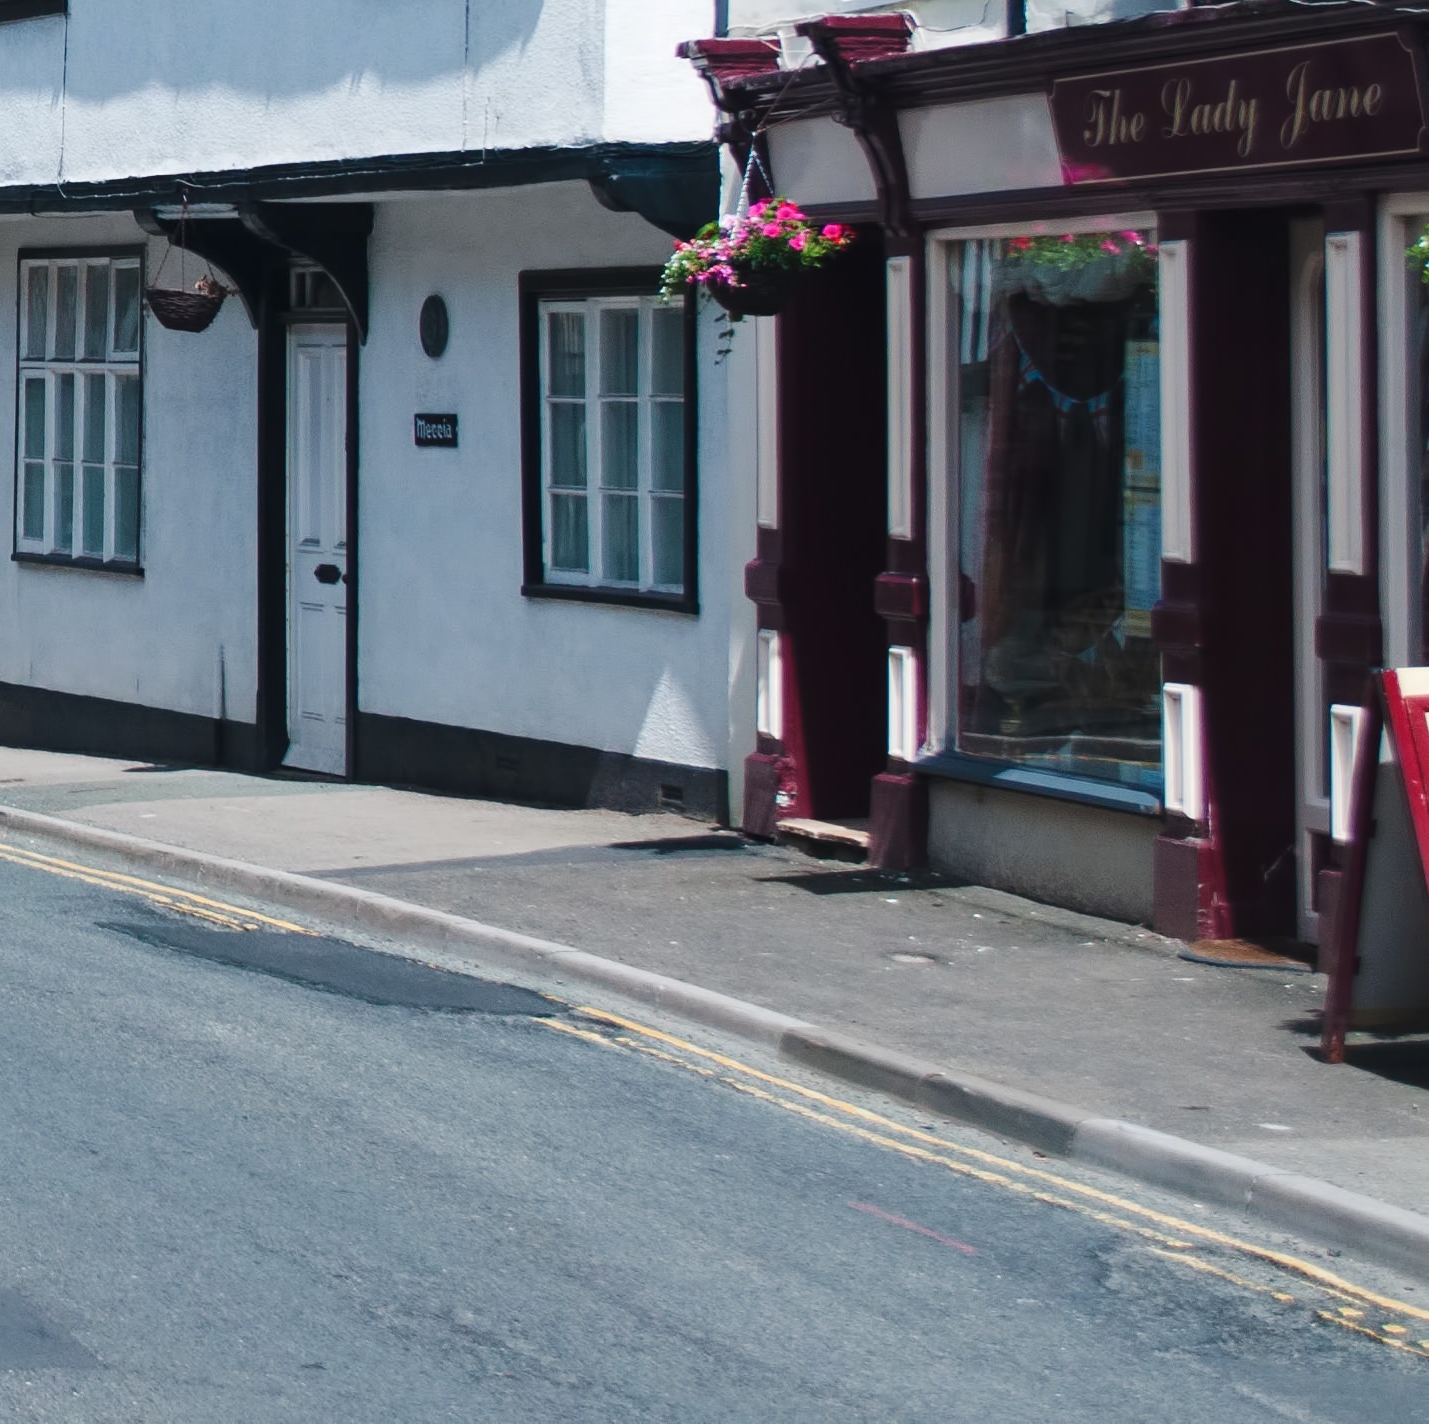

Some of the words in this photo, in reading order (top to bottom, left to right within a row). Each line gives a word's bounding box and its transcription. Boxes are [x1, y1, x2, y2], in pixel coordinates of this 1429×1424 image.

[1082, 88, 1146, 148] The
[1160, 78, 1259, 158] Lady
[1280, 60, 1383, 150] Jane
